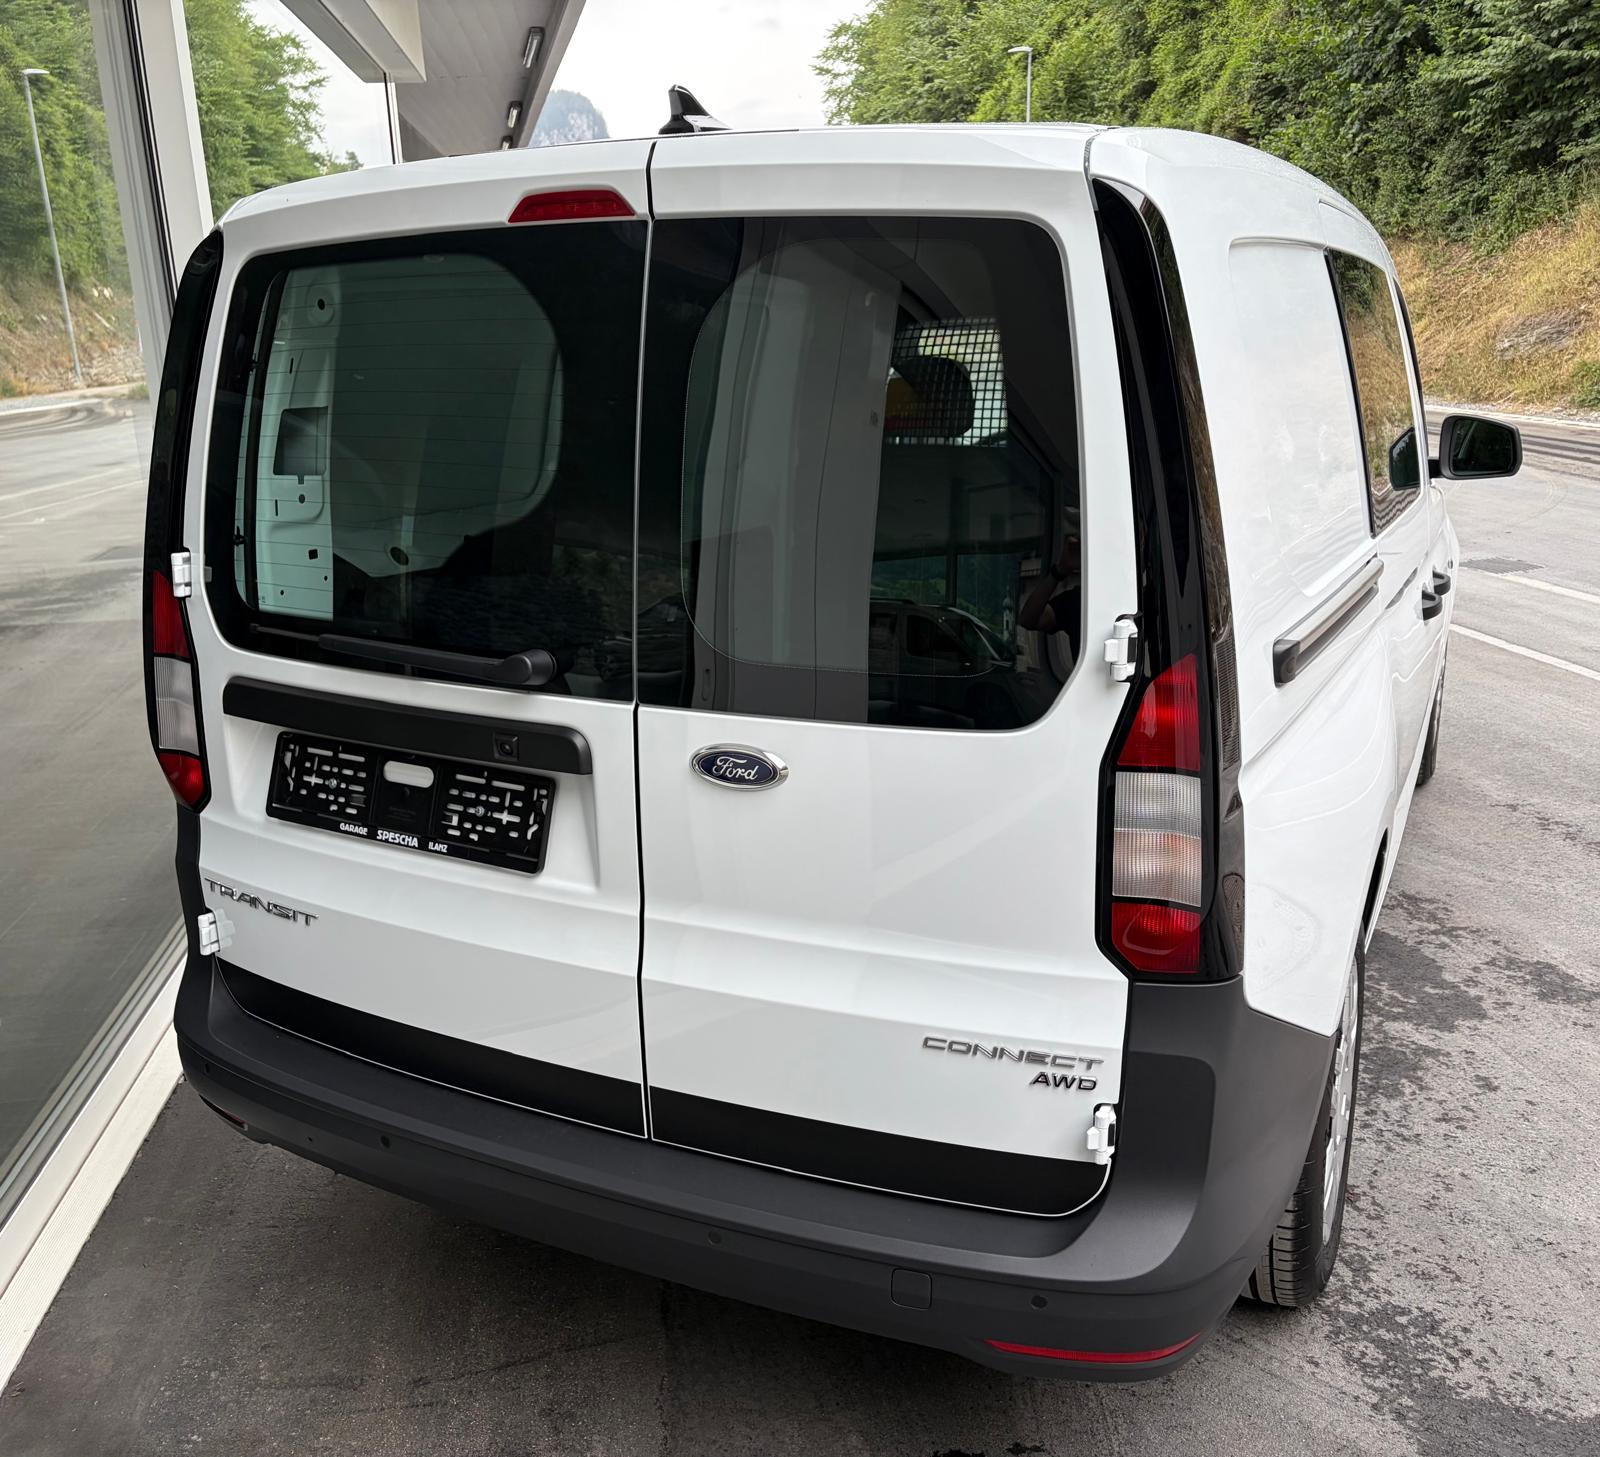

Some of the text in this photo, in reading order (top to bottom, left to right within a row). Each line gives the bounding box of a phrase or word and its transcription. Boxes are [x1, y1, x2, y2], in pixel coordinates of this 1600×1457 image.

[712, 756, 760, 780] Ford
[339, 822, 448, 853] GARAGE SPESCHA ILANZ
[204, 877, 319, 926] TRANSIT
[922, 1036, 1105, 1071] CONNECT
[1029, 1071, 1098, 1091] AWD
